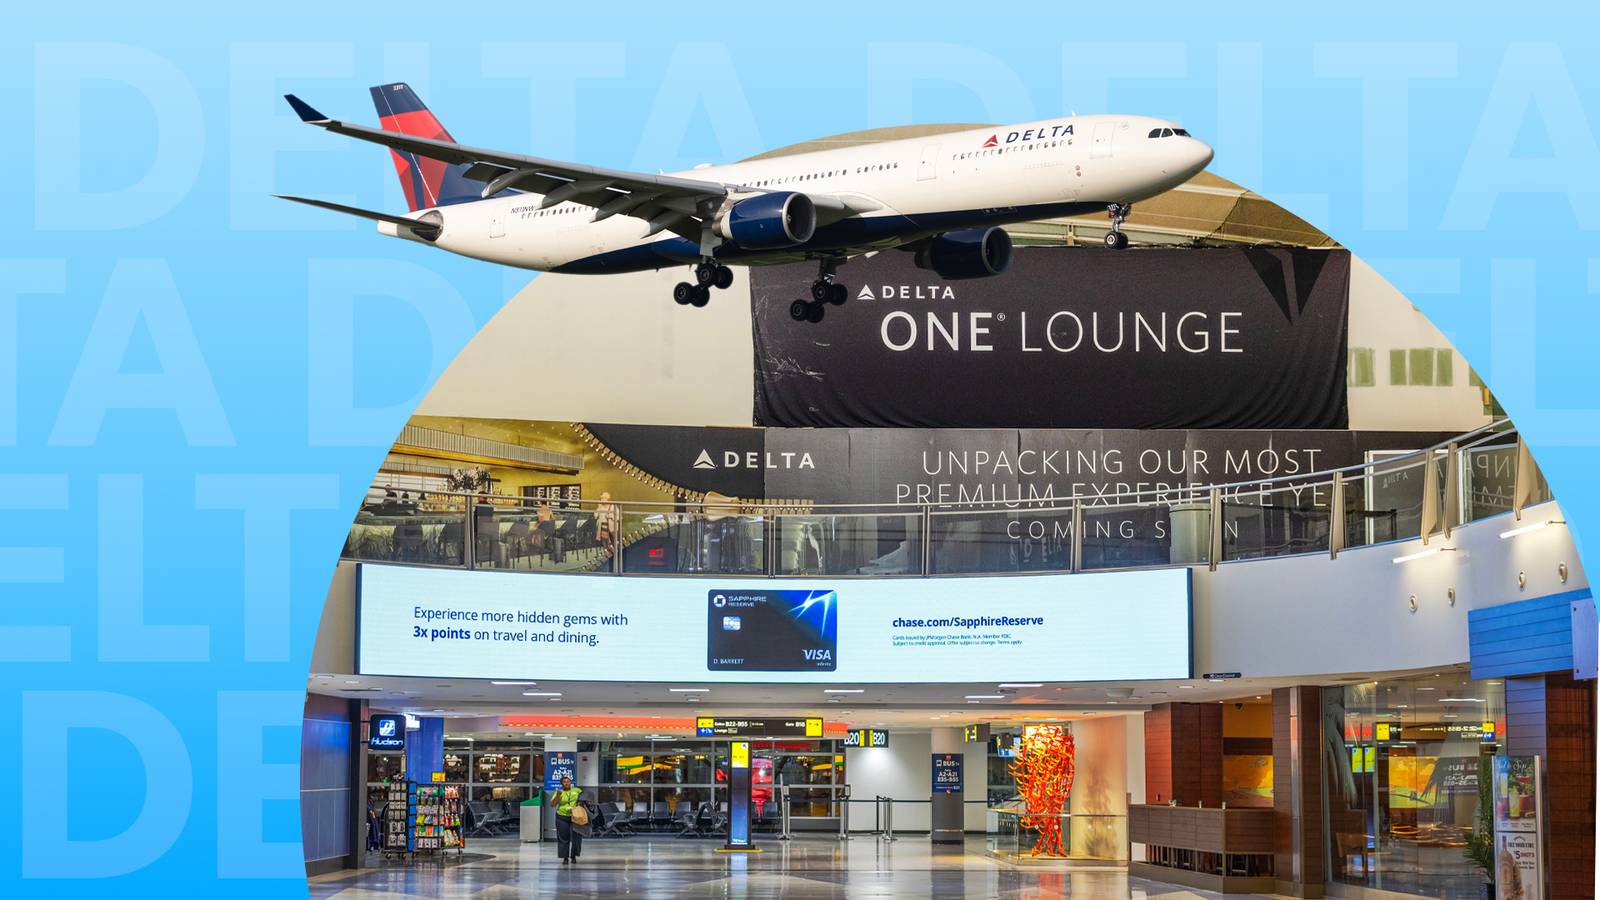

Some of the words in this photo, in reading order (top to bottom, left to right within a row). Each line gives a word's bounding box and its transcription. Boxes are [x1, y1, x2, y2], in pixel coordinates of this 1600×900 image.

[1006, 124, 1074, 143] DELTA
[882, 285, 955, 299] DELTA
[1021, 310, 1244, 353] LOUNGE
[724, 451, 815, 469] DELTA
[923, 449, 1123, 475] UNPACKING
[1139, 449, 1209, 475] OUR
[1225, 448, 1322, 475] MOST
[896, 483, 1055, 507] PREMIUM
[1289, 482, 1348, 507] YE
[1007, 520, 1134, 539] COMING
[1154, 520, 1238, 539] SN
[414, 606, 478, 622] Experience
[481, 611, 514, 622] more
[517, 610, 560, 624] hidden
[563, 614, 597, 628] gems
[601, 613, 628, 626] with
[892, 616, 1044, 629] chase.com/SapphireReserve
[413, 625, 428, 638] 3x
[431, 626, 471, 641] points
[474, 630, 490, 640] on
[493, 629, 527, 642] travel
[531, 630, 554, 643] and
[558, 631, 600, 647] dining.
[802, 649, 831, 660] VISA
[371, 737, 403, 745] Hudson
[873, 732, 885, 745] B20
